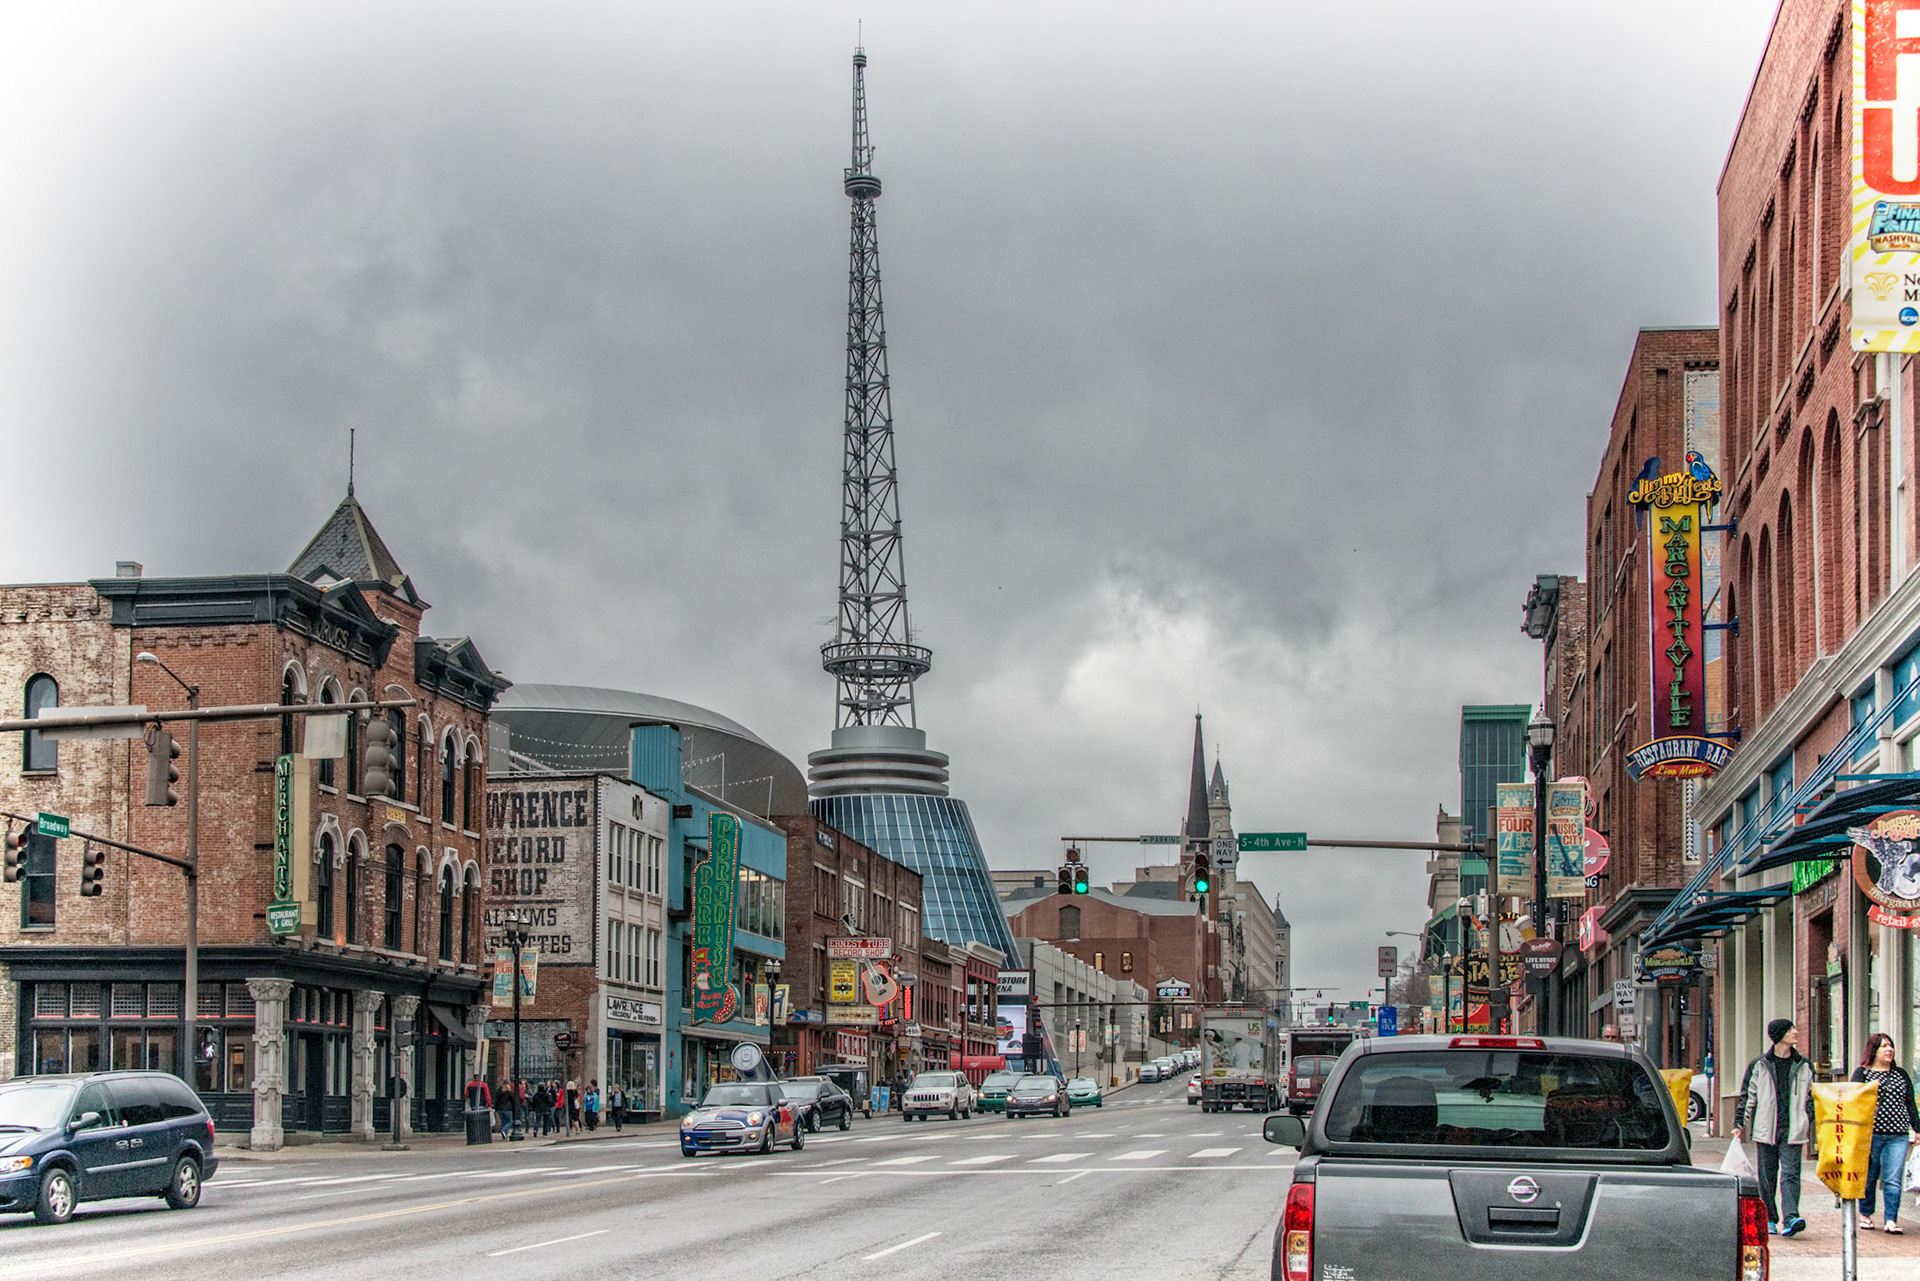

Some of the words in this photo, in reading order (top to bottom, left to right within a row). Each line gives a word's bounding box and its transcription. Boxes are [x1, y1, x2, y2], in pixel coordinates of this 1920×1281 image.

[1904, 289, 1920, 301] M
[1629, 472, 1690, 503] Jimmy
[1660, 515, 1692, 727] MARGARITAVILLE
[1633, 740, 1700, 767] RESTAURANT
[1705, 744, 1728, 765] BAR
[1655, 765, 1677, 775] Live
[1680, 764, 1707, 775] Music
[40, 817, 67, 836] Broadway
[277, 762, 289, 894] MERCHANTS
[1498, 818, 1533, 832] FOUR
[1150, 837, 1180, 845] PARKING
[1562, 835, 1584, 845] CITY
[486, 836, 565, 864] ECORD
[491, 868, 547, 896] SHOP
[698, 865, 713, 945] PARK
[711, 816, 734, 989] PARADISE
[270, 909, 298, 920] RESTAURANT
[1876, 913, 1907, 927] retail
[274, 920, 279, 928] &
[281, 919, 293, 928] GRILL
[485, 934, 572, 954] SSTTES
[829, 939, 862, 949] ERNEST
[867, 939, 890, 949] TUBB
[833, 949, 863, 957] RECORD
[865, 949, 885, 957] SHOP
[607, 998, 643, 1014] LAWRENCE
[1381, 1023, 1397, 1031] STOP
[1835, 1088, 1845, 1165] SERVED
